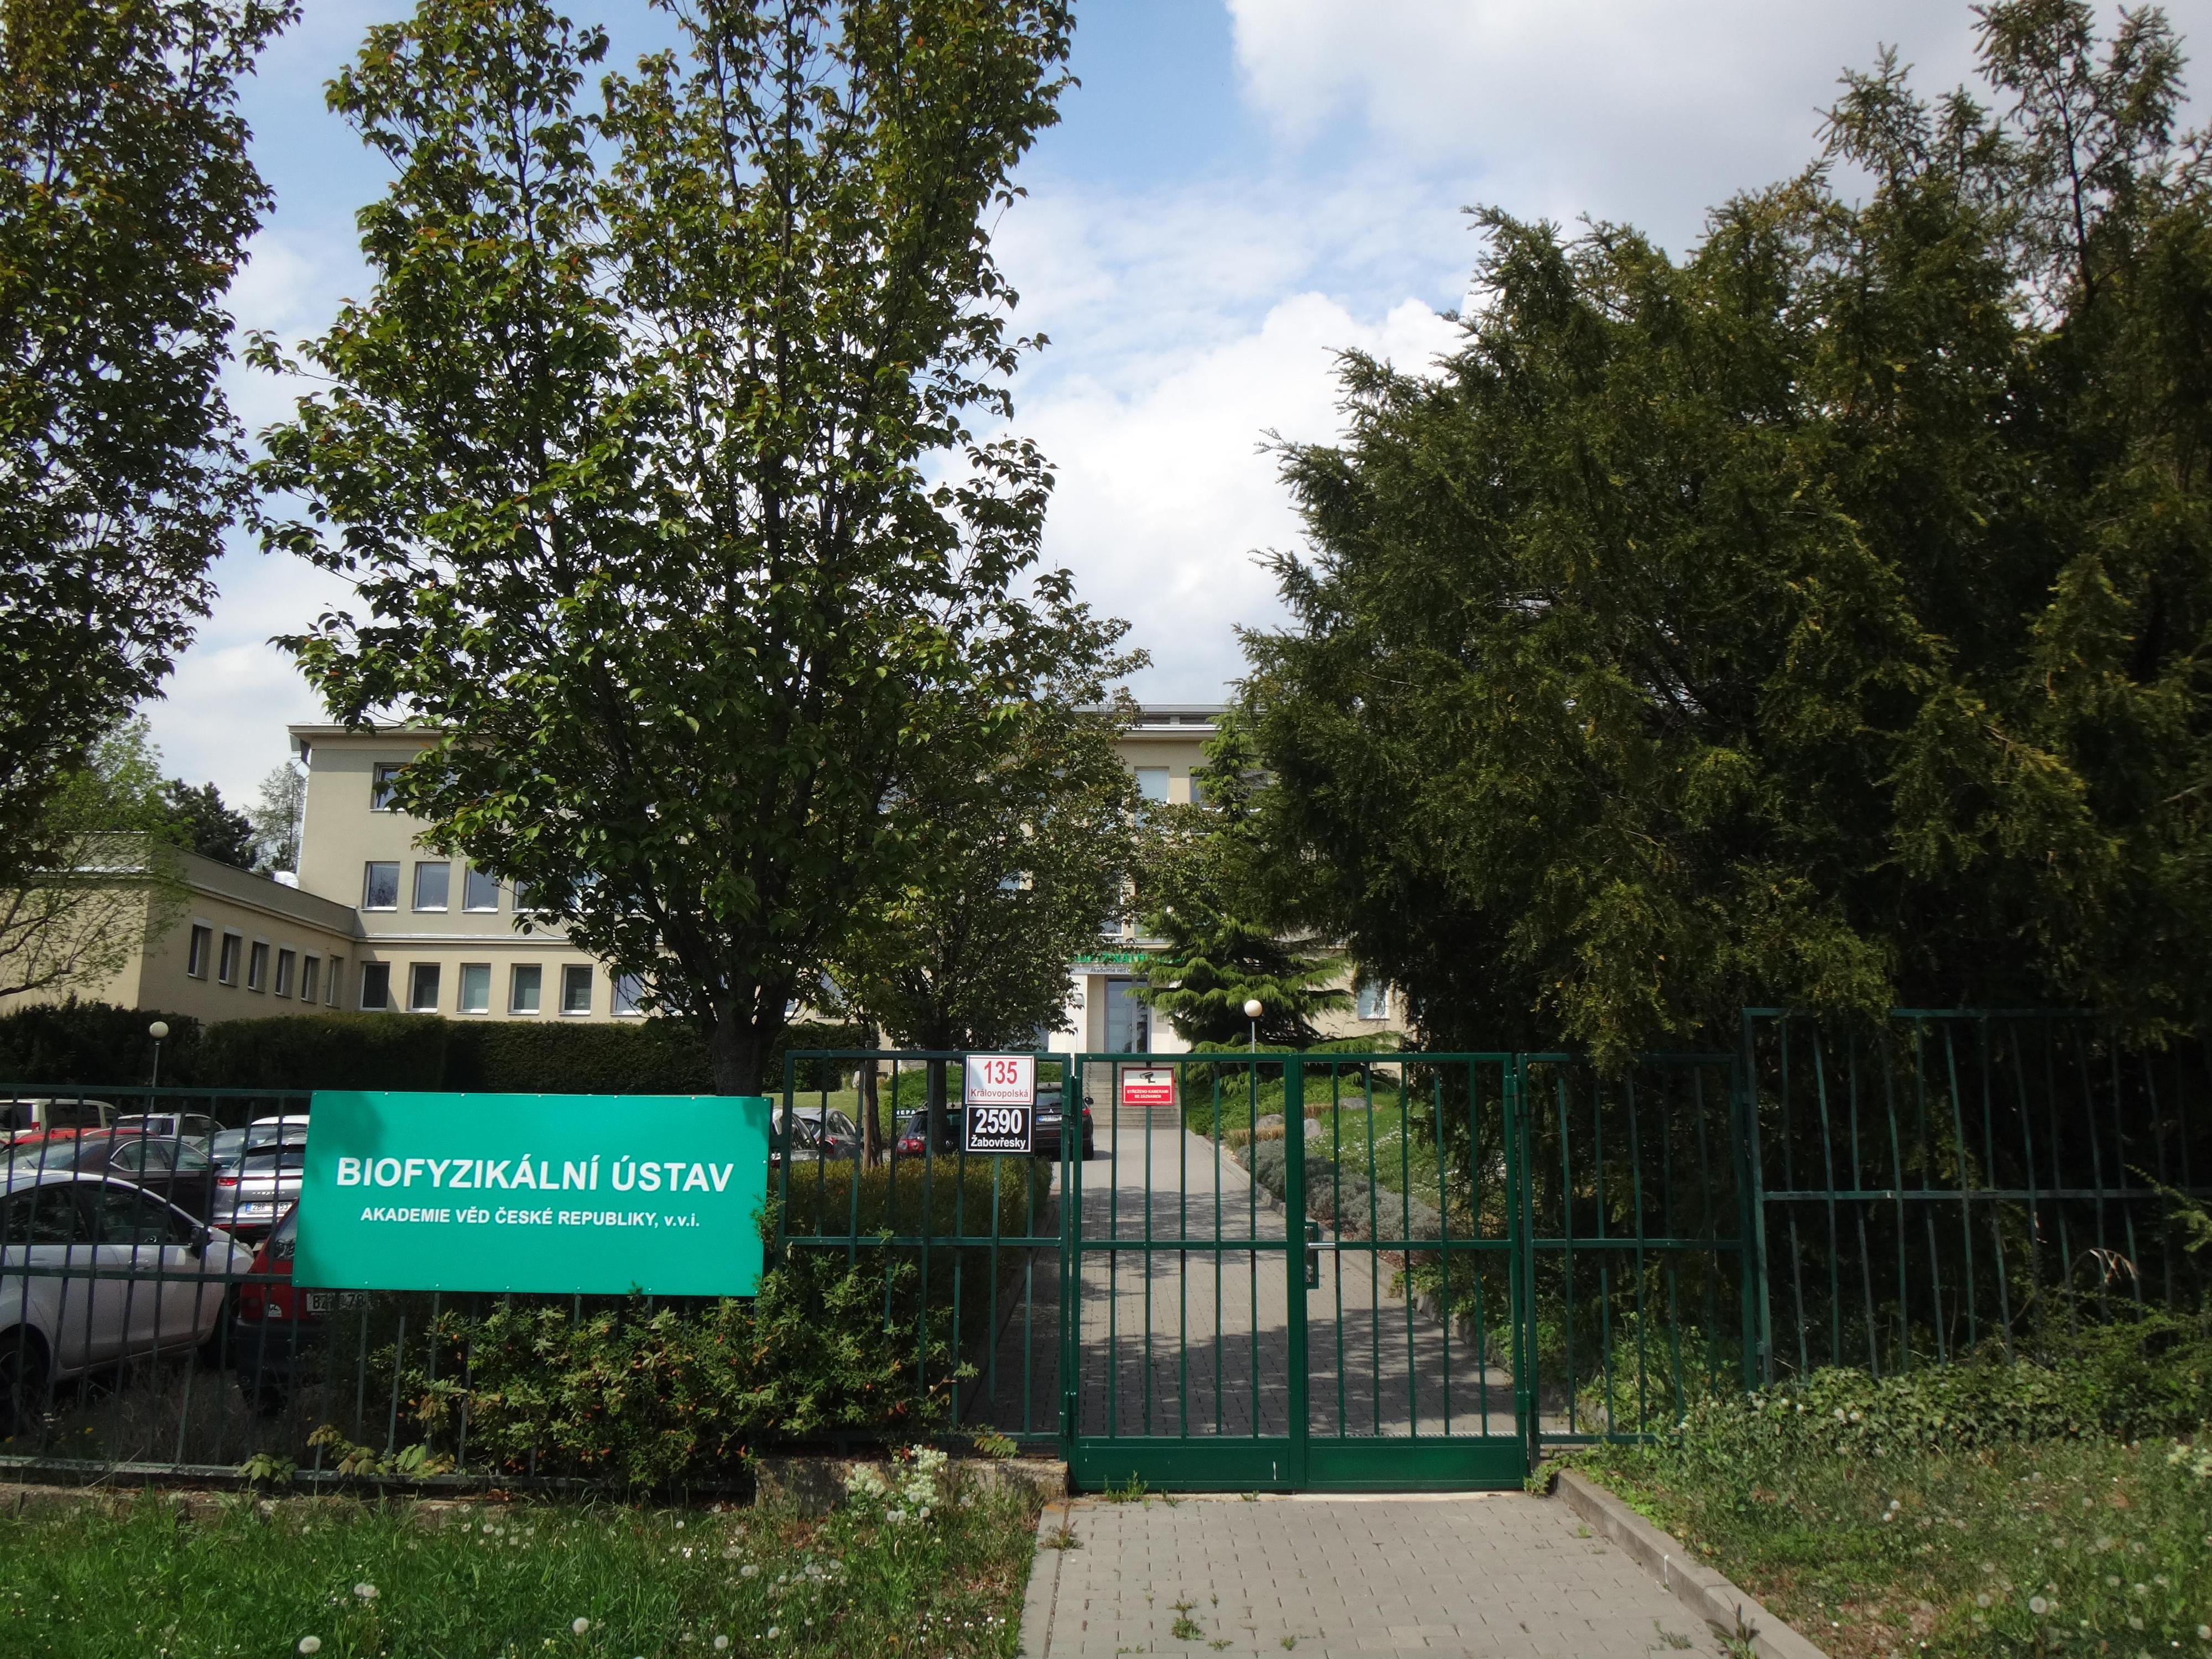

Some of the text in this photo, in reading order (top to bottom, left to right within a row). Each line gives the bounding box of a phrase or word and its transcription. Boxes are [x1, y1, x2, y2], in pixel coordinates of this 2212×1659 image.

[984, 1061, 1018, 1084] 135
[971, 1089, 1029, 1099] Královopolská
[975, 1109, 1022, 1134] 2590
[971, 1135, 1026, 1149] Žabovřesky
[337, 1154, 734, 1192] BIOFYZIKÁLNÍ ÚSTAV
[361, 1206, 700, 1228] AKADEMIE VĚD ČESKÉ REPUBLIKY, v.v.i.
